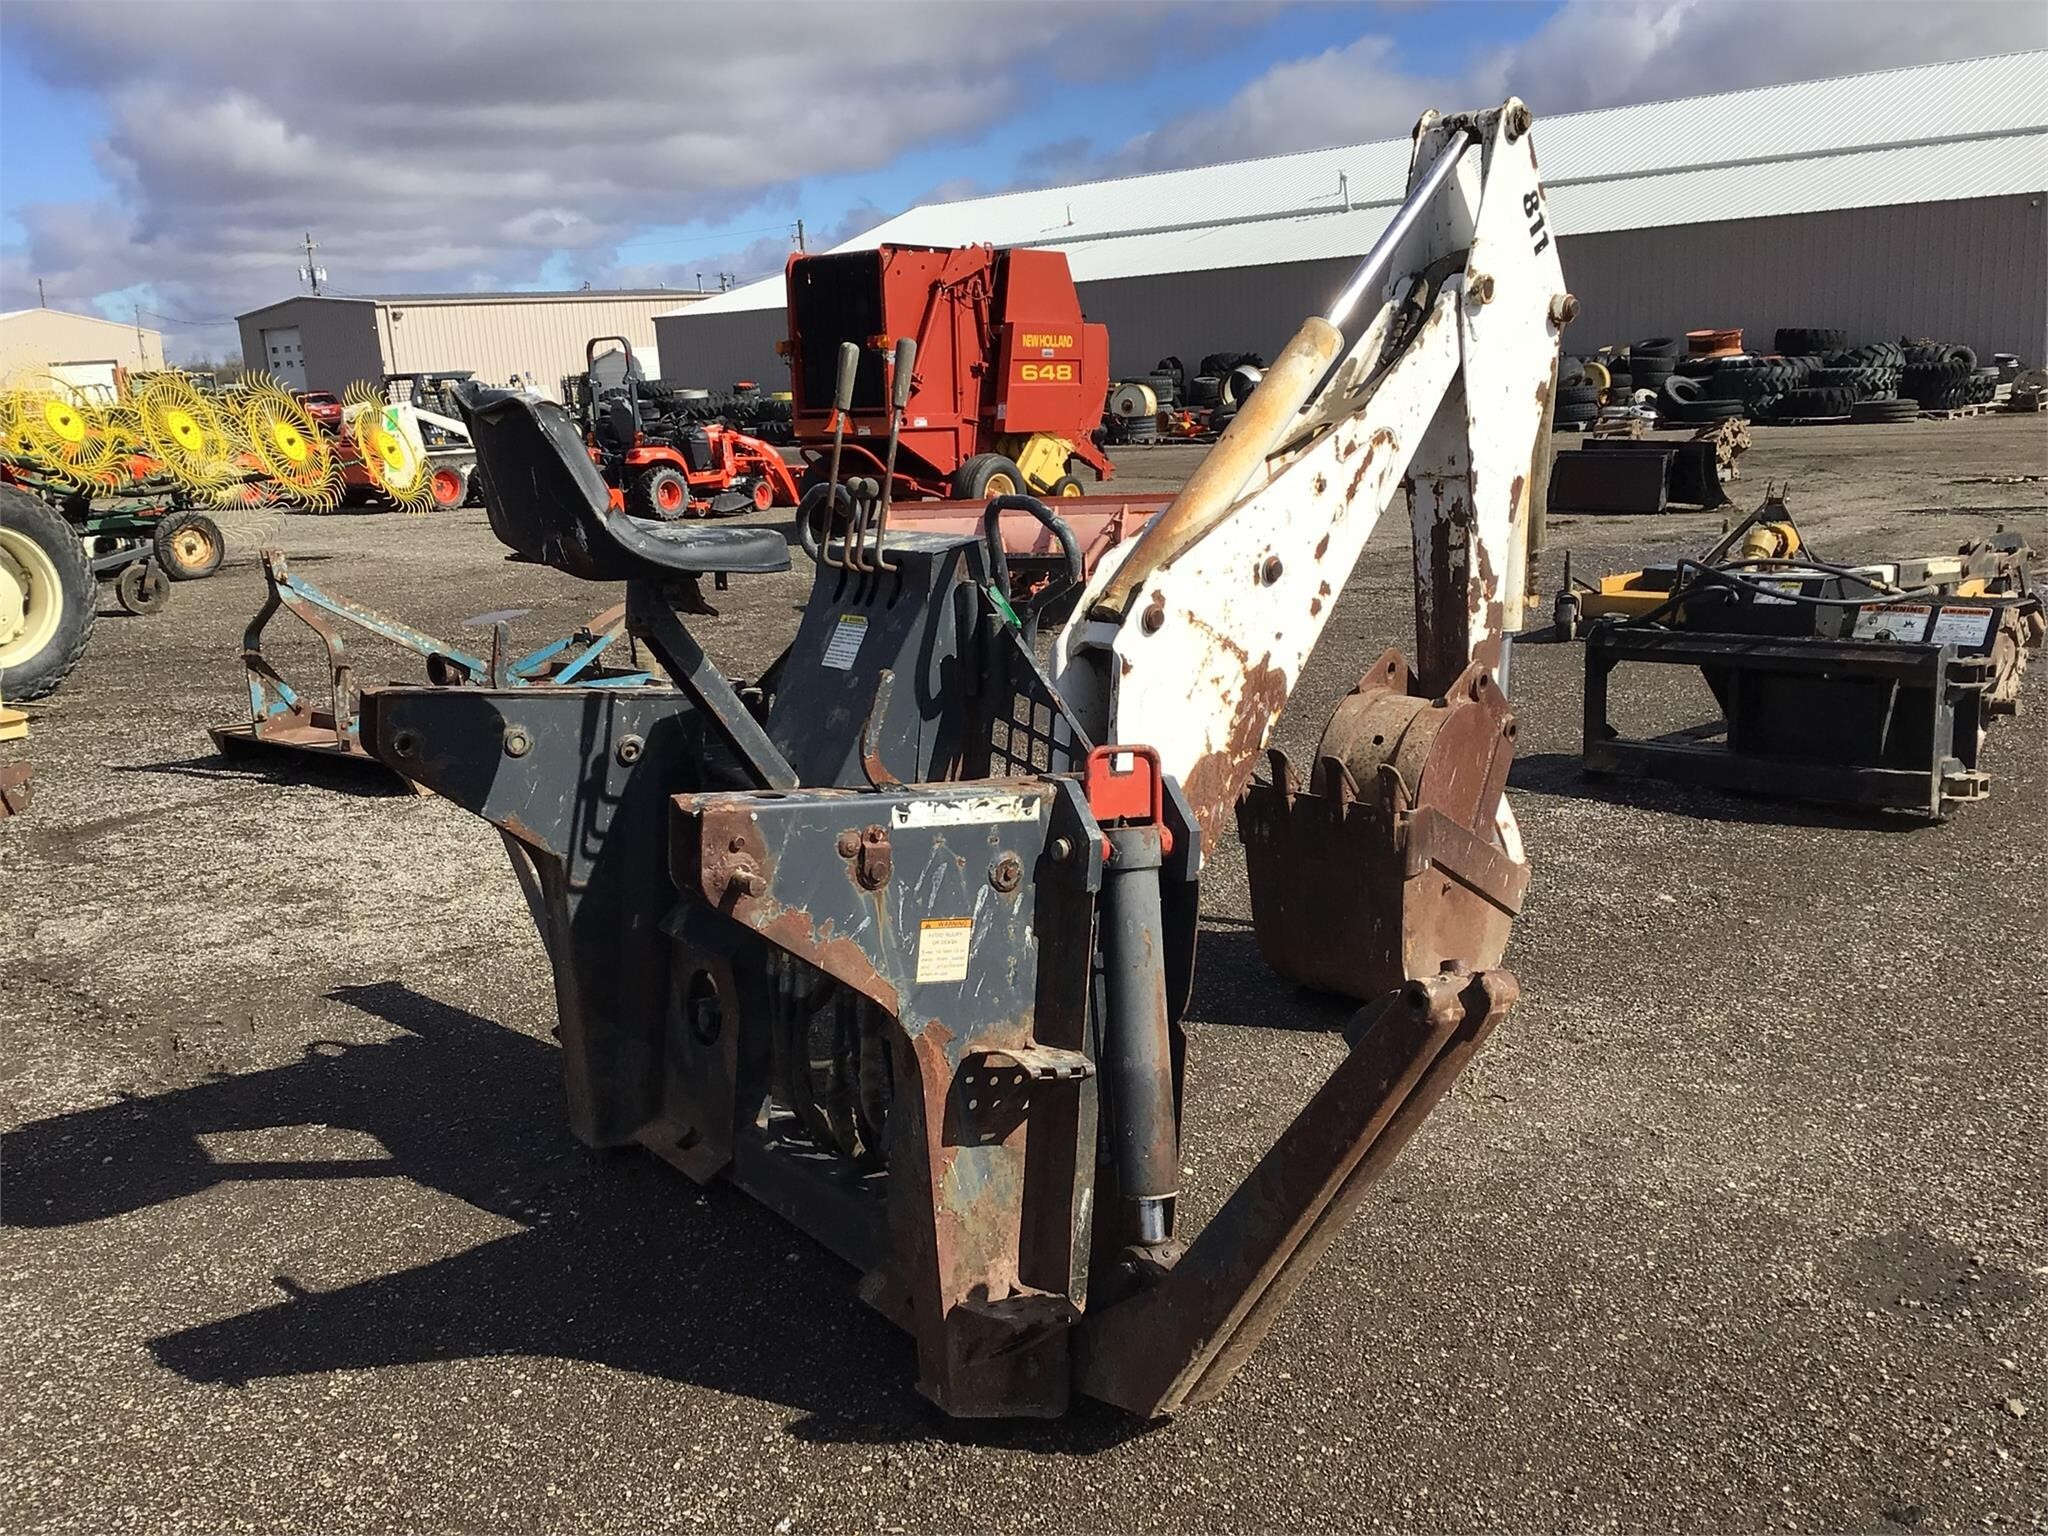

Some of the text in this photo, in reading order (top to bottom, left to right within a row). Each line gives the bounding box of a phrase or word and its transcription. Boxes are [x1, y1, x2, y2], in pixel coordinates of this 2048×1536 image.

[1523, 190, 1549, 256] 811
[1022, 334, 1073, 348] NEW HOLLAND
[1021, 364, 1072, 381] 648
[1874, 604, 1925, 614] WARNING
[1947, 608, 1990, 616] WARNING
[938, 920, 968, 928] WARNING
